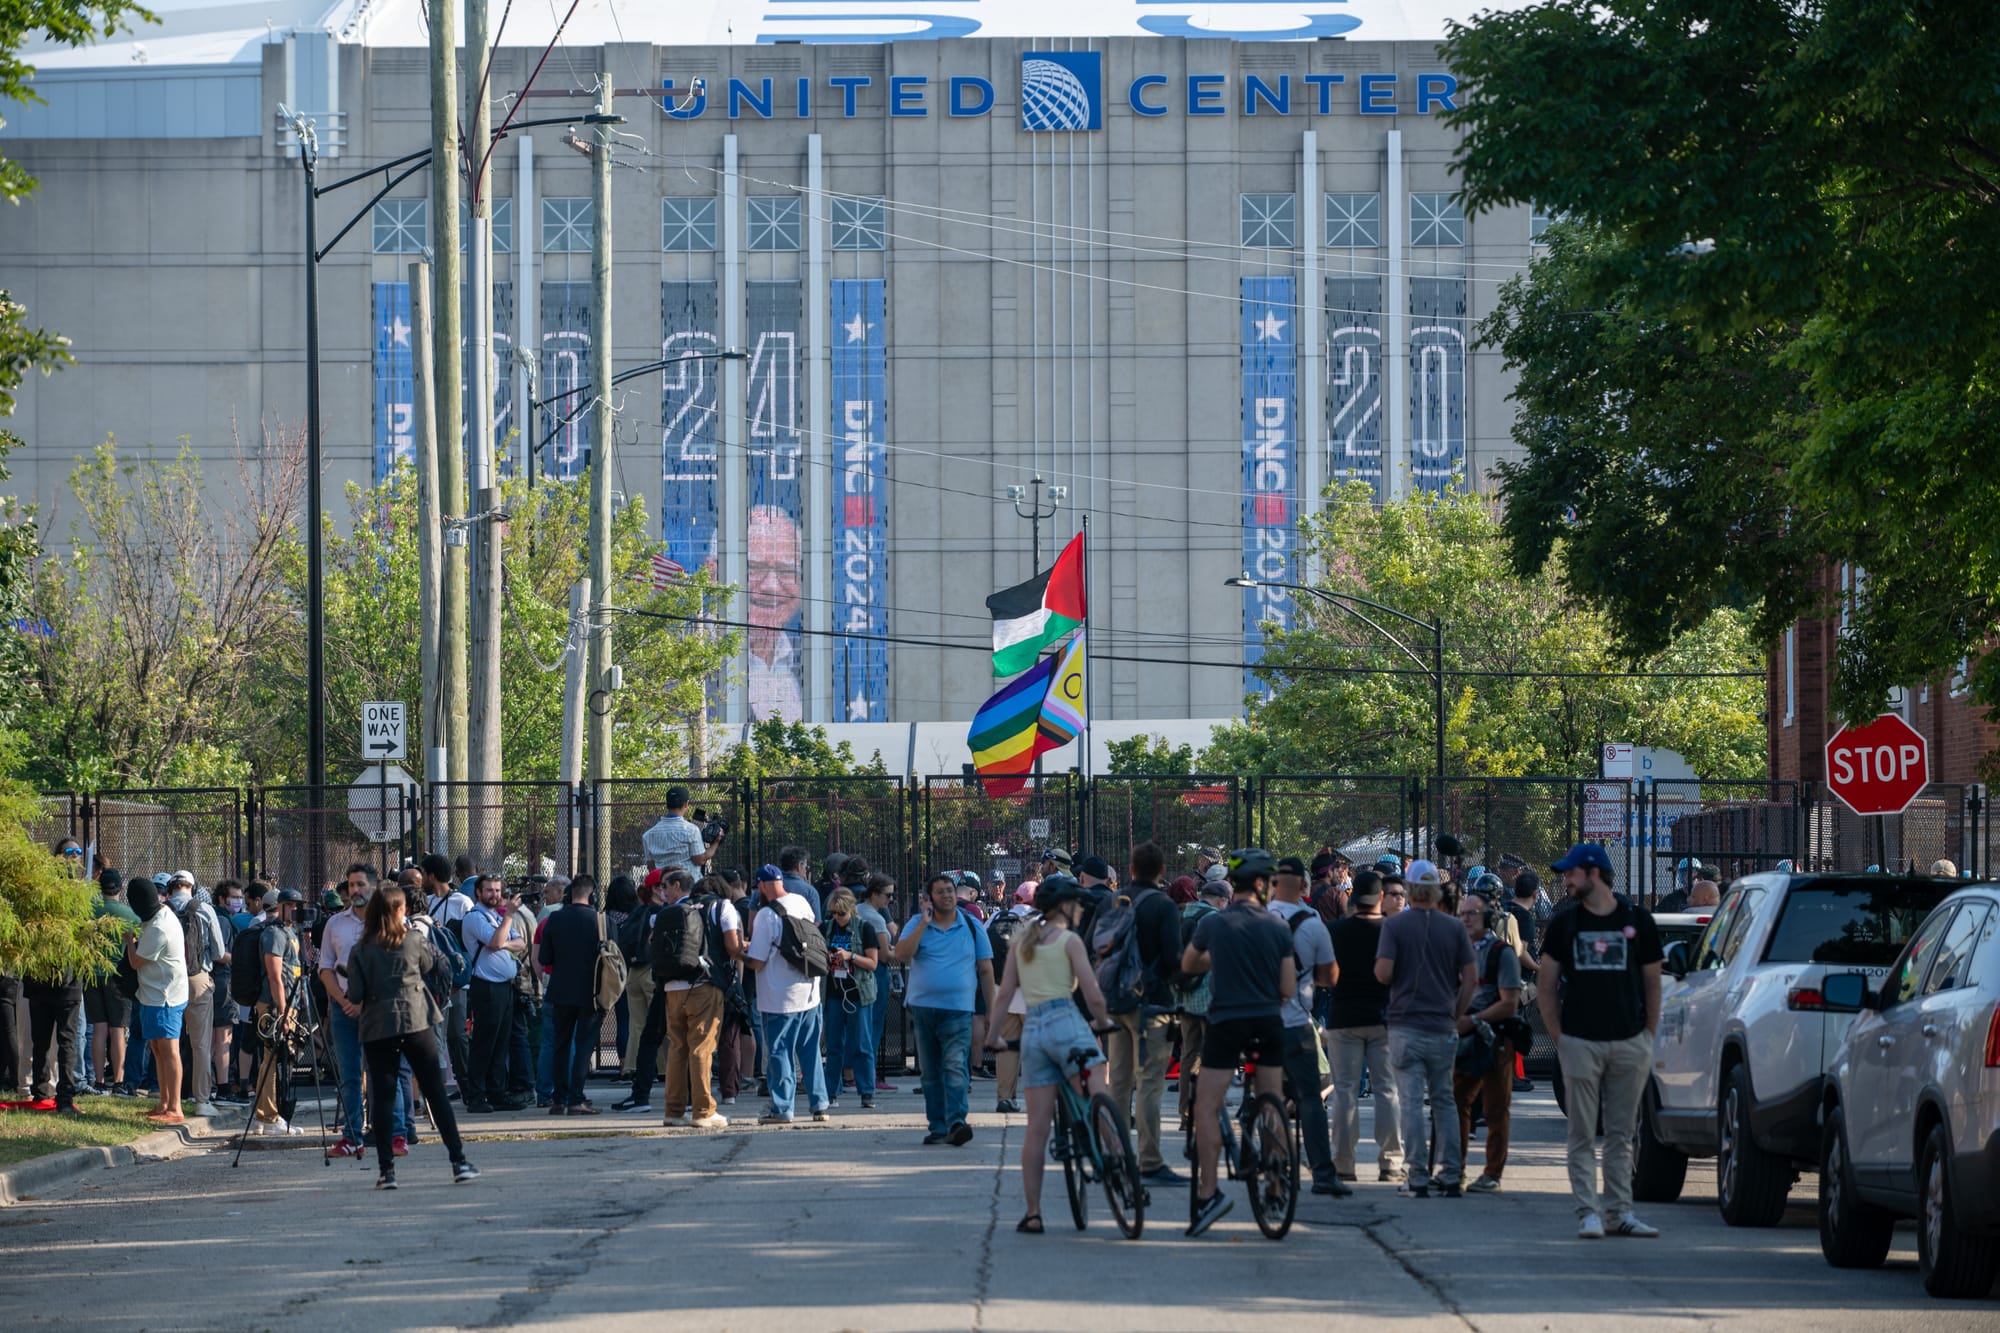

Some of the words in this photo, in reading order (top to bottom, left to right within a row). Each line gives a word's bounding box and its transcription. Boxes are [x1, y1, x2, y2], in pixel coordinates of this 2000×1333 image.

[662, 75, 995, 120] UNITED
[1128, 73, 1459, 116] CENTER
[844, 400, 875, 493] DNC
[1255, 398, 1287, 492] DNC
[845, 529, 875, 633] 2024
[367, 723, 400, 737] WAY
[368, 707, 399, 721] ONE
[1833, 745, 1920, 784] STOP
